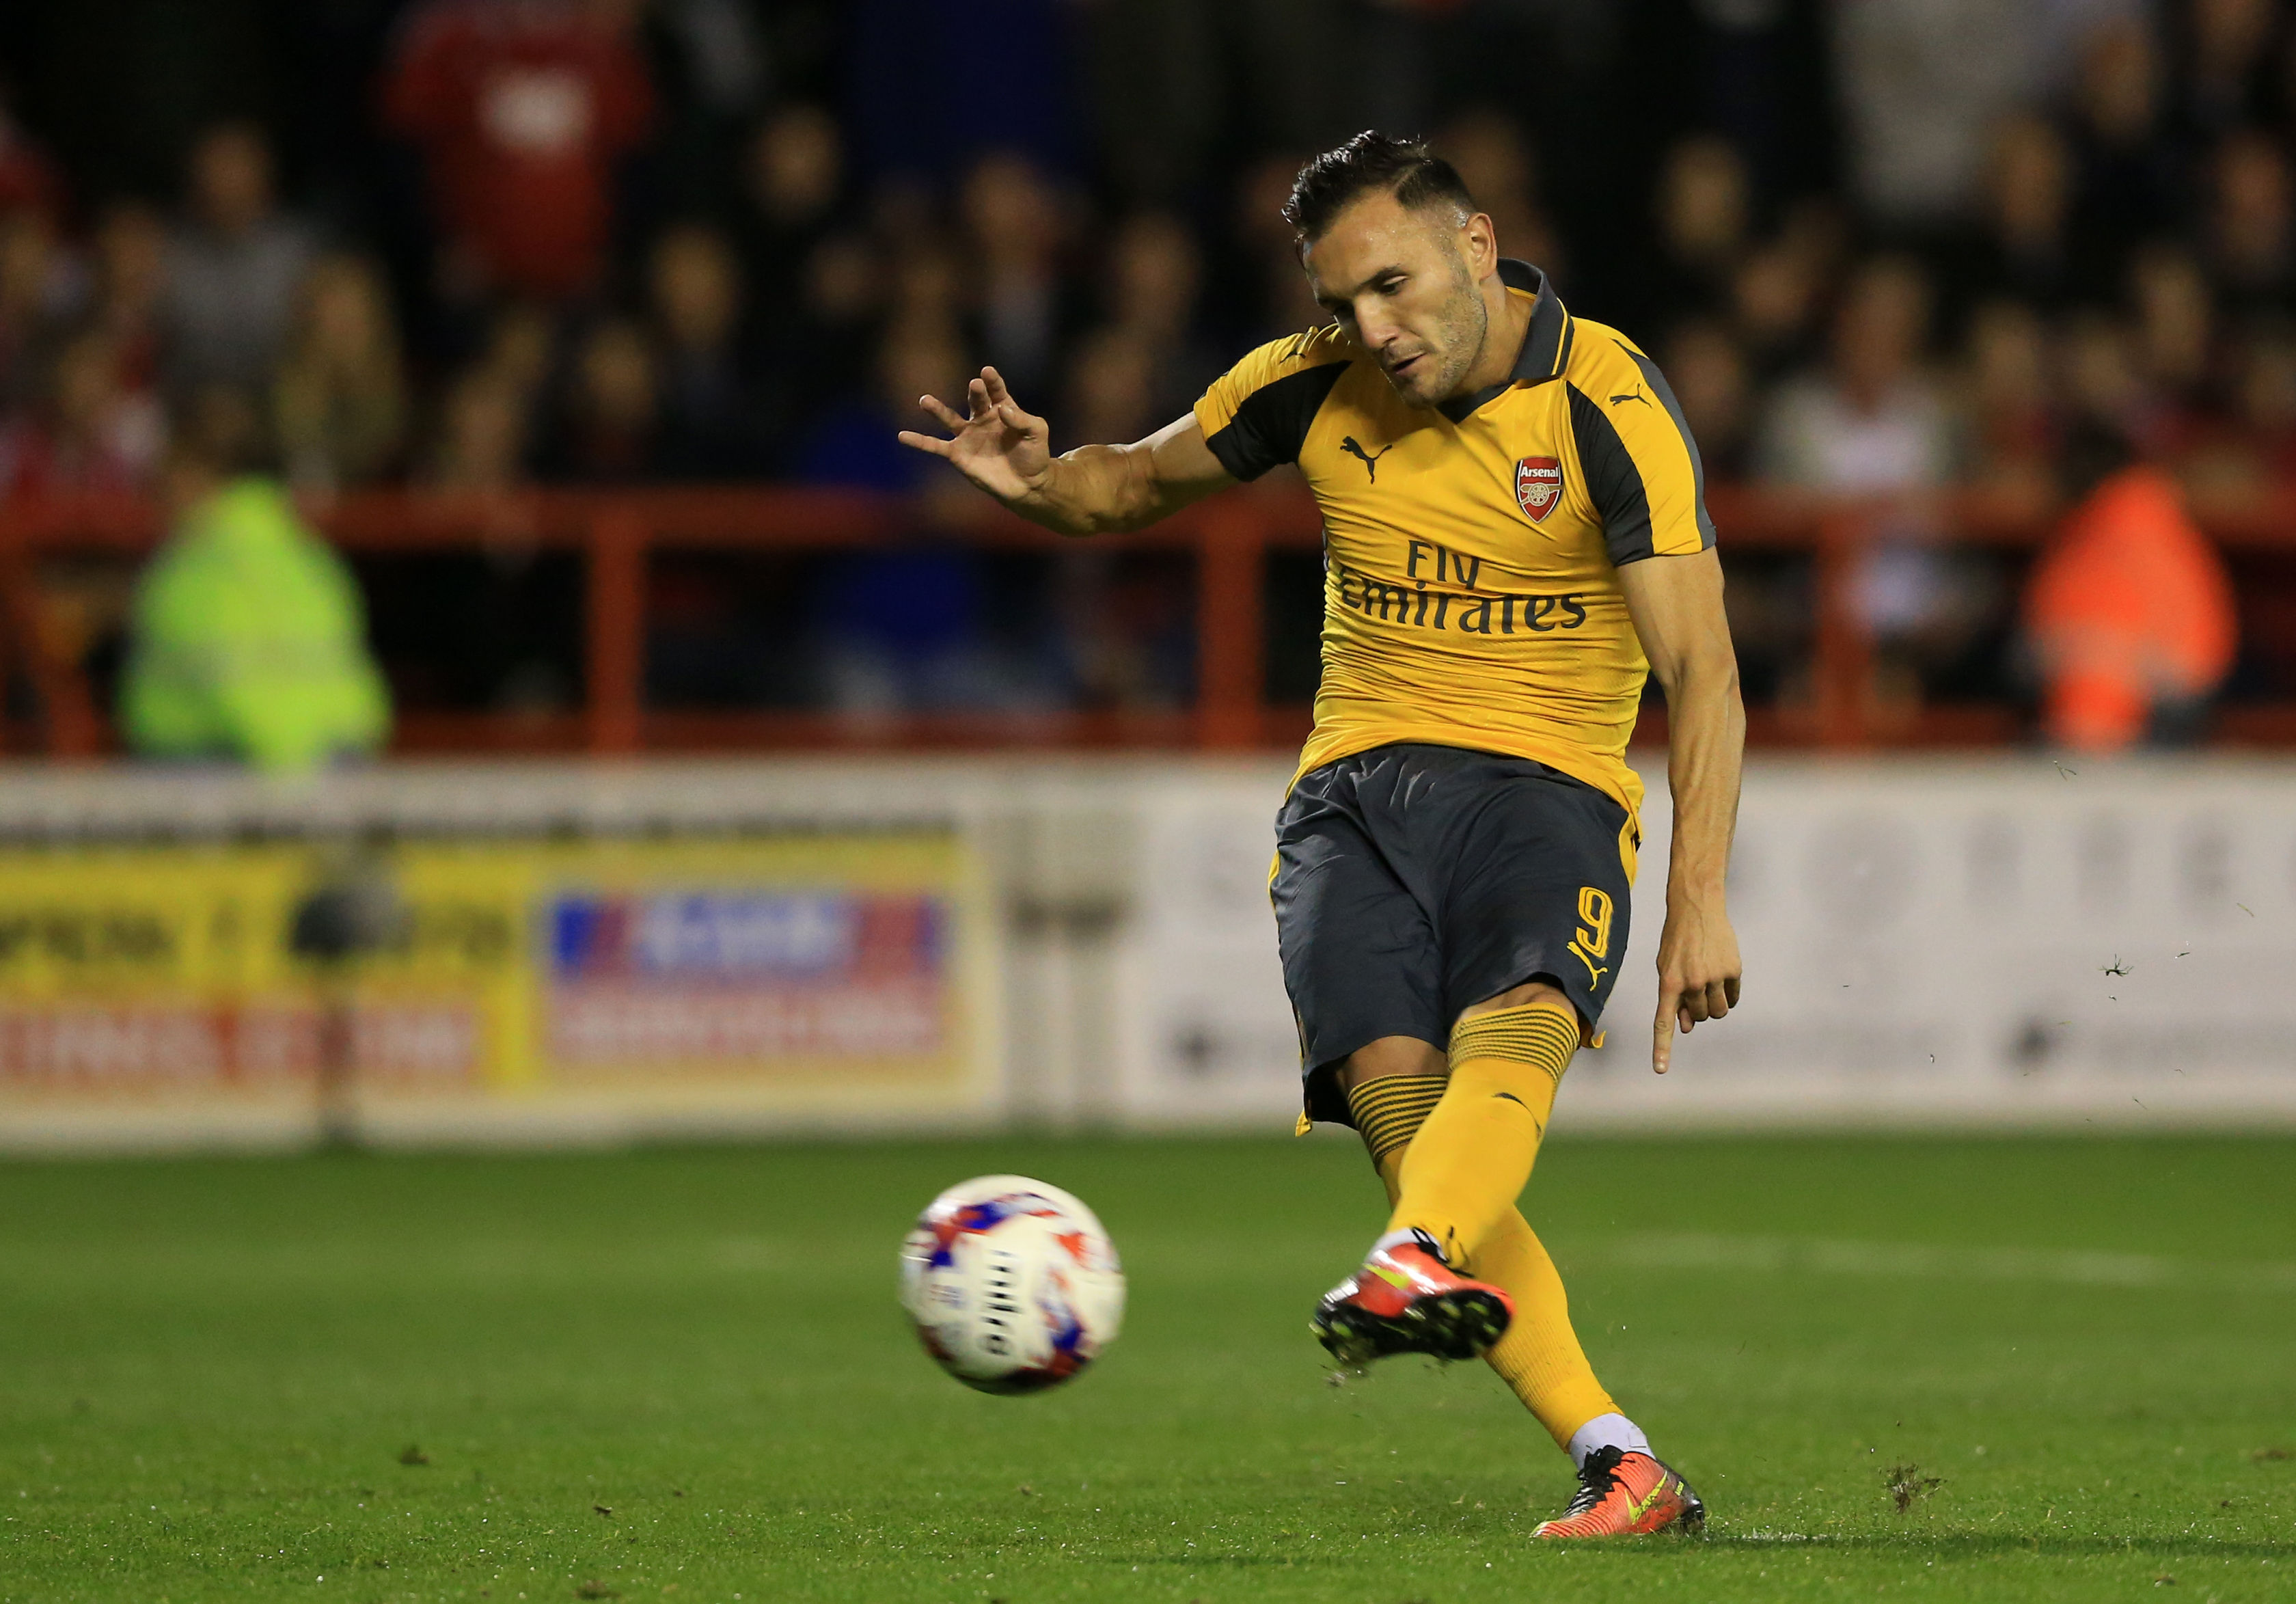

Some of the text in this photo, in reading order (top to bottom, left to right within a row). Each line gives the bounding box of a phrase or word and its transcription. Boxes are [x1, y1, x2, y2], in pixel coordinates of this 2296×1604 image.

[1520, 466, 1559, 477] Arsenal
[1407, 539, 1479, 590] Fly
[1340, 567, 1586, 634] Emirates
[1576, 886, 1613, 958] 9
